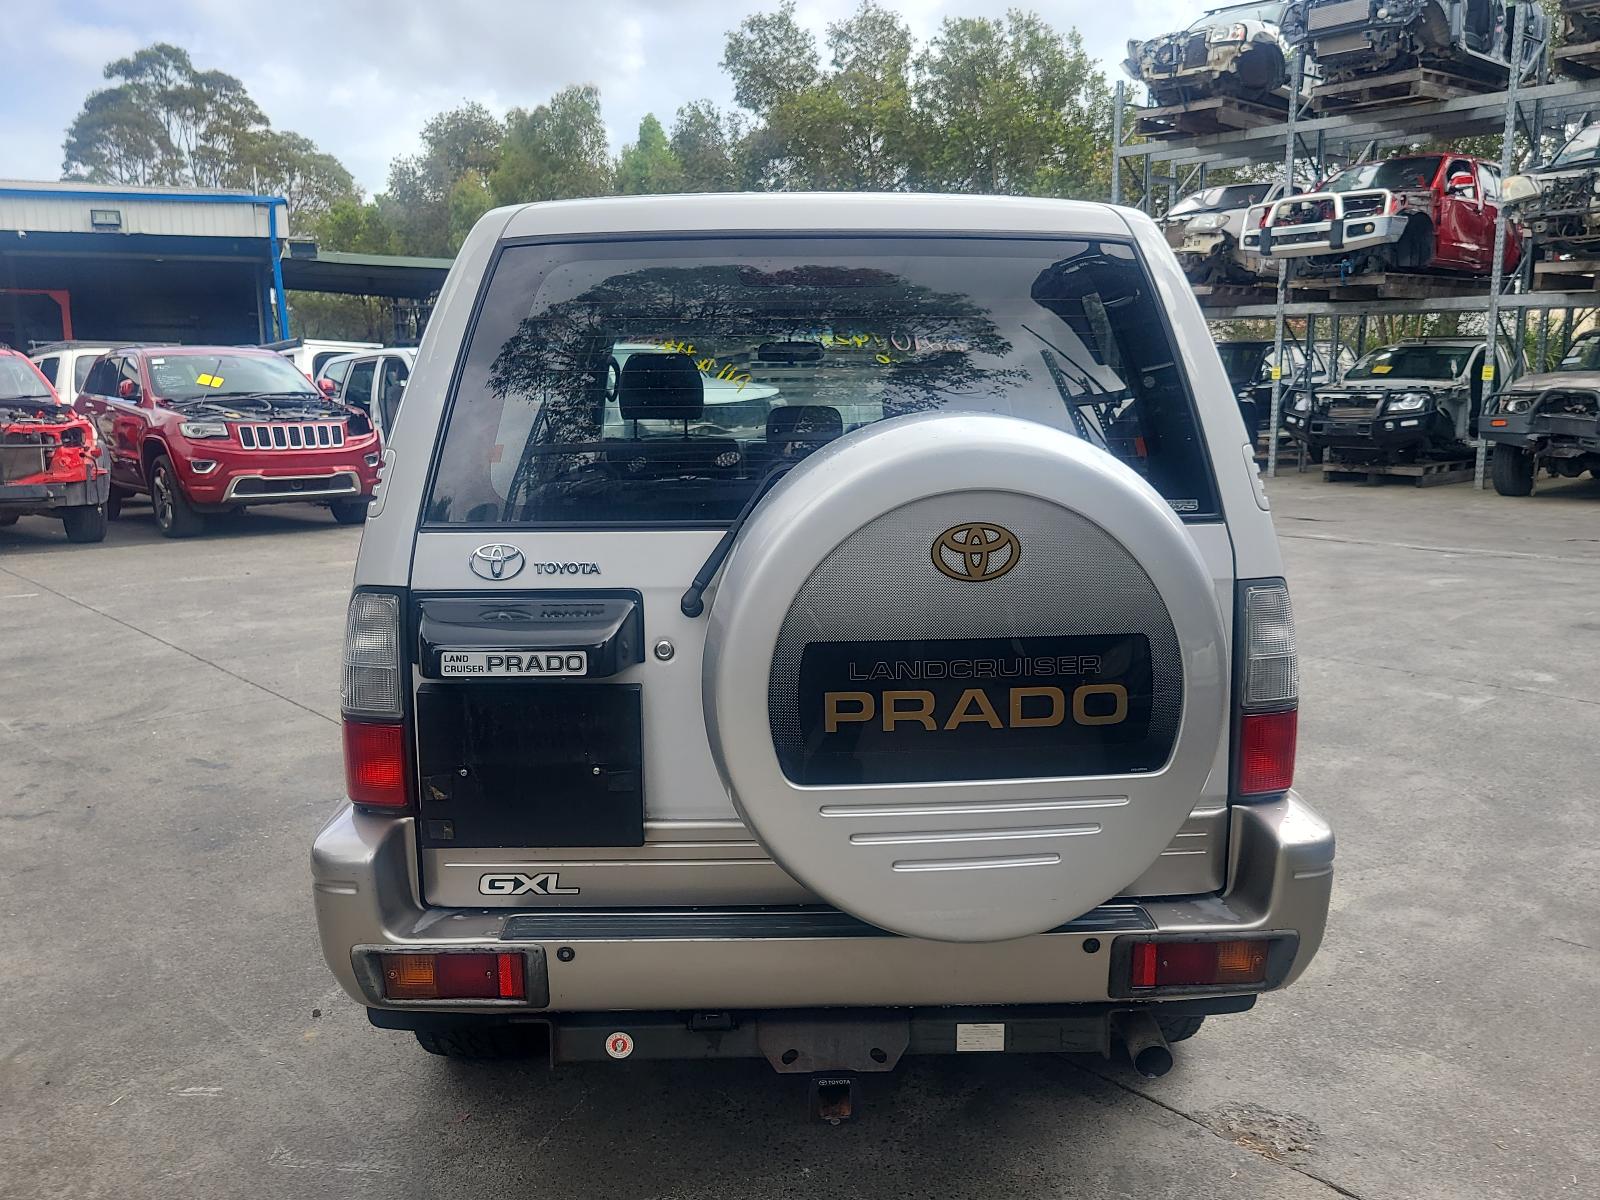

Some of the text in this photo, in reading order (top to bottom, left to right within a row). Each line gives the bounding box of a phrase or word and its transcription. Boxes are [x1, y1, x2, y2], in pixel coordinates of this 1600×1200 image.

[534, 561, 601, 575] TOYOTA
[444, 655, 469, 663] LAND
[486, 654, 584, 673] PRADO
[849, 655, 1102, 681] LANDCRUISER
[444, 665, 485, 673] CRUISER
[824, 683, 1128, 733] PRADO
[478, 872, 580, 895] GXL
